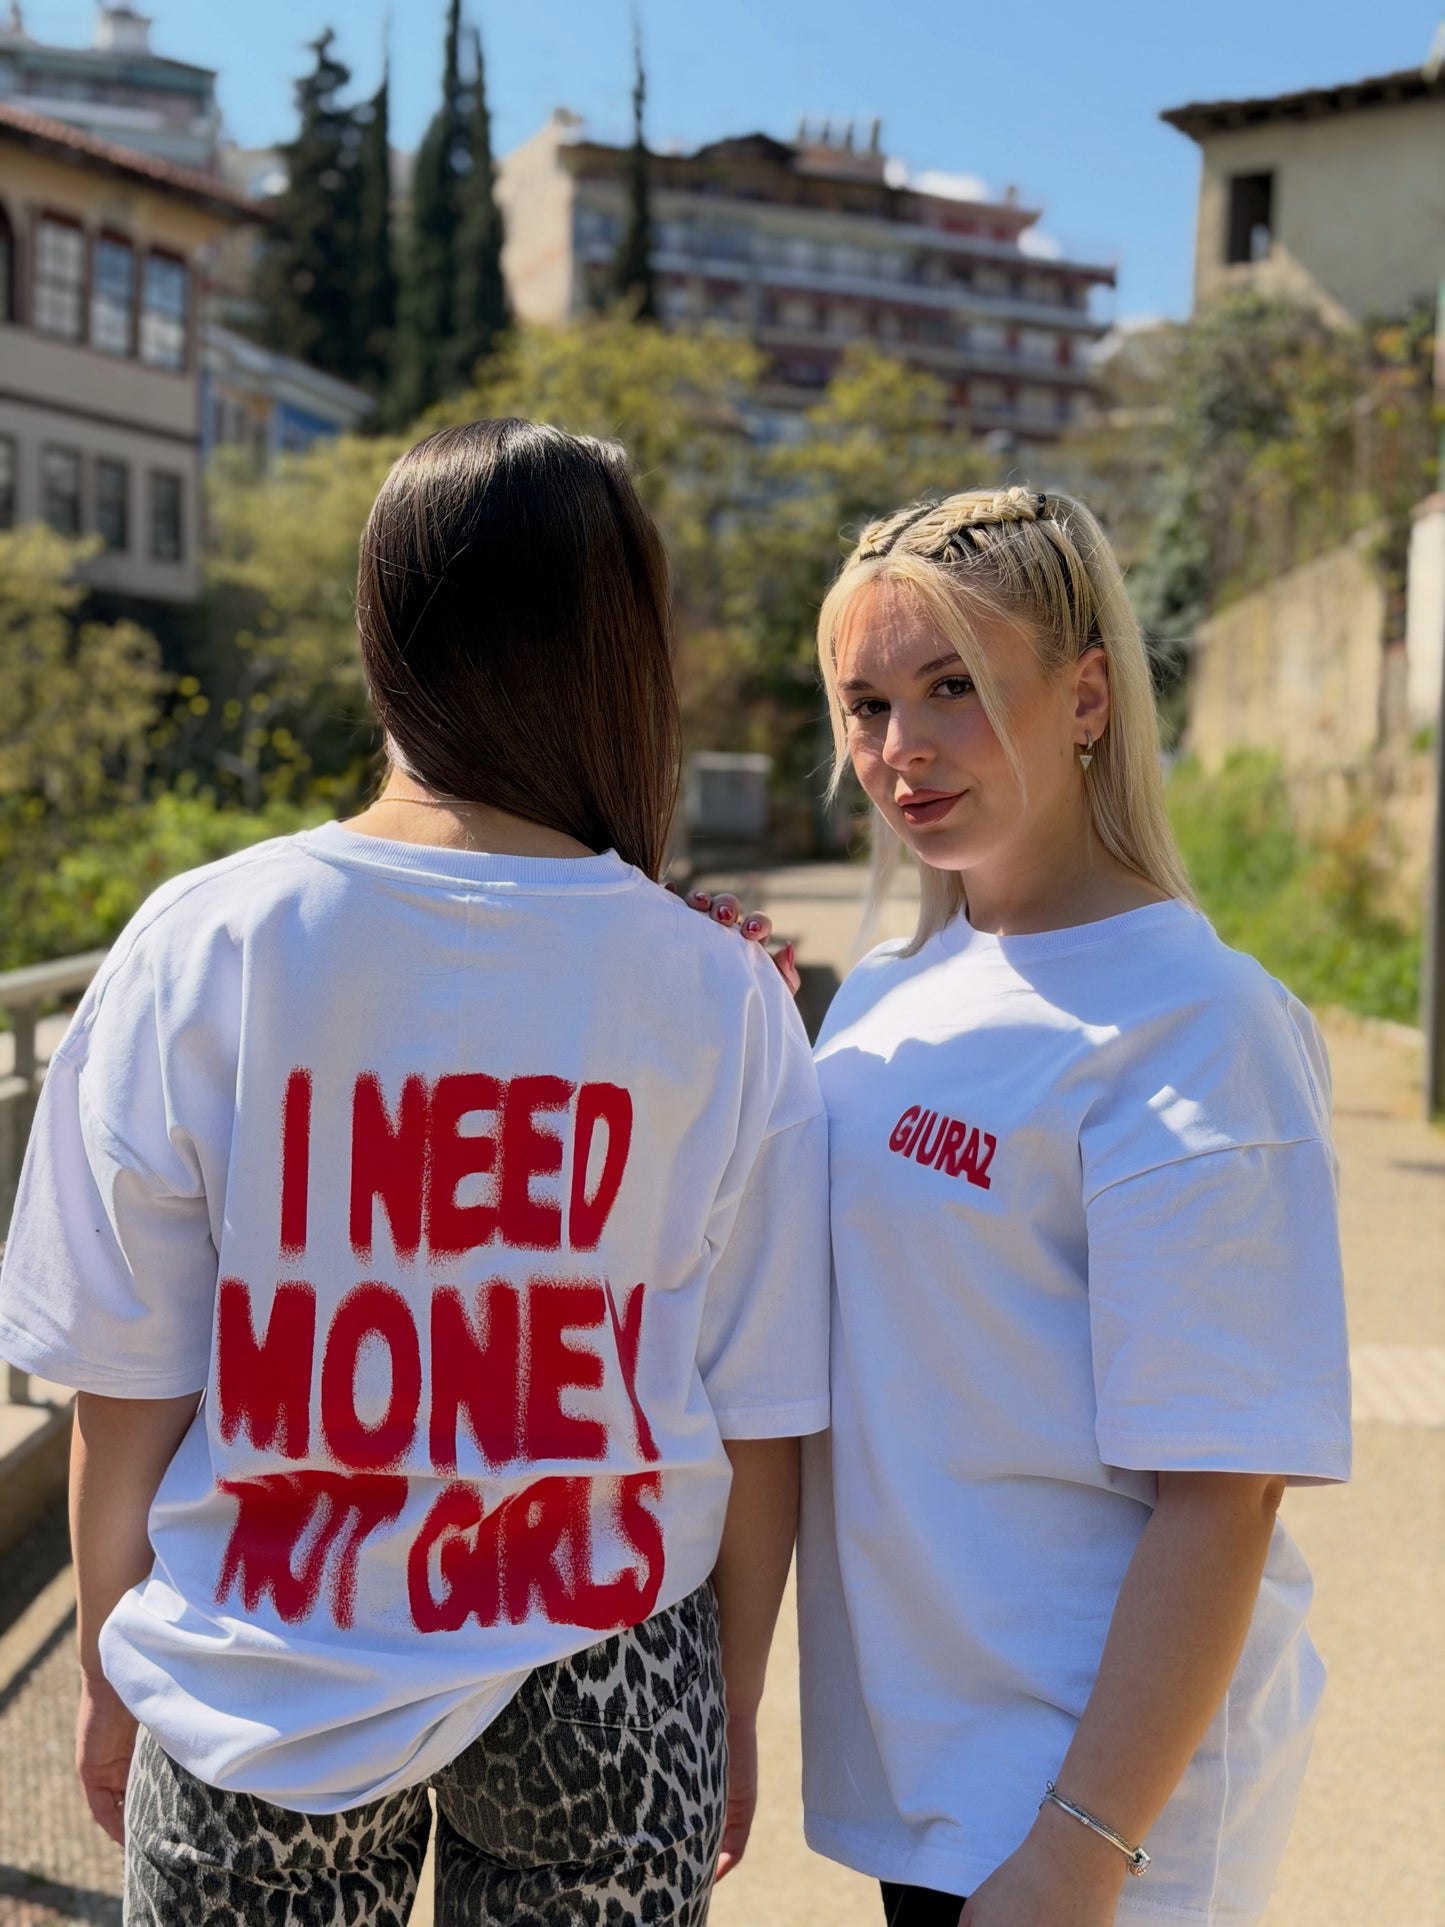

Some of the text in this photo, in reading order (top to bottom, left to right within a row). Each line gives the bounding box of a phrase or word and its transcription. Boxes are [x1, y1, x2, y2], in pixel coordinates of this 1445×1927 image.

[279, 1067, 633, 1258] I NEED
[888, 1104, 997, 1190] GIURAZ
[217, 1277, 661, 1474] MONEY
[408, 1471, 665, 1633] GIRLS
